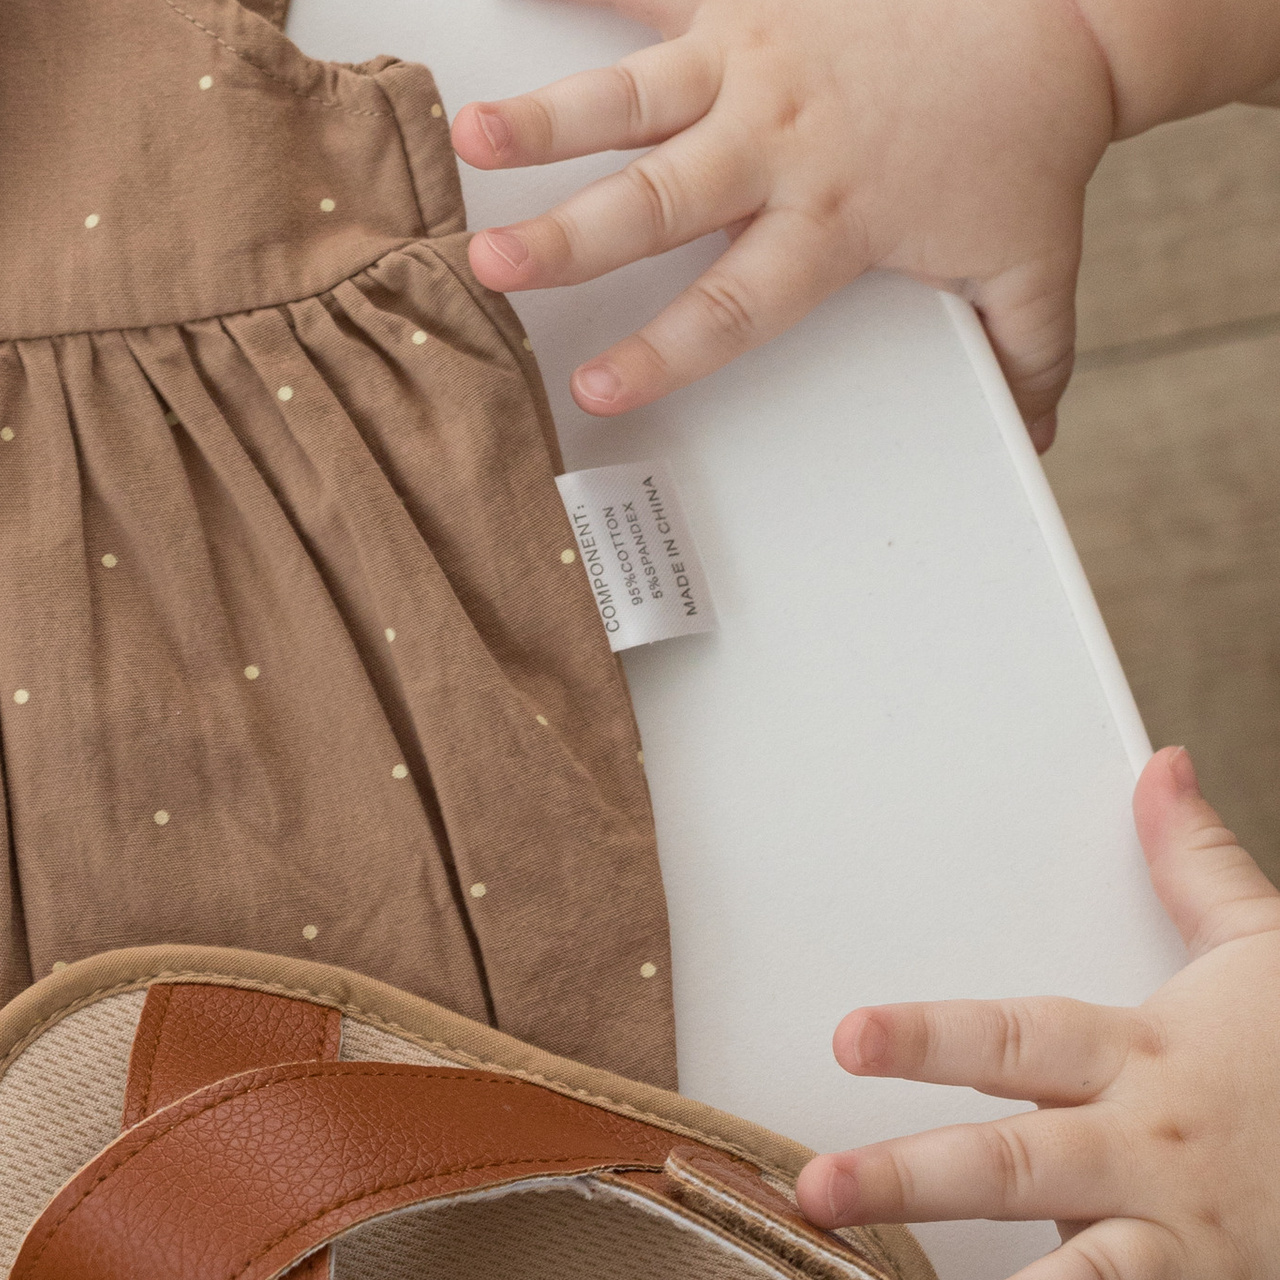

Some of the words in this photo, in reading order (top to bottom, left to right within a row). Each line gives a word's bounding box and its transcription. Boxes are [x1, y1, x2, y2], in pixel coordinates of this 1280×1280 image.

[642, 475, 671, 535] CHINA
[572, 504, 620, 634] COMPONENT:
[602, 506, 643, 607] 95%COTTON
[621, 500, 664, 600] 5%SPANDEX
[663, 539, 681, 558] IN
[671, 561, 698, 617] MADE
